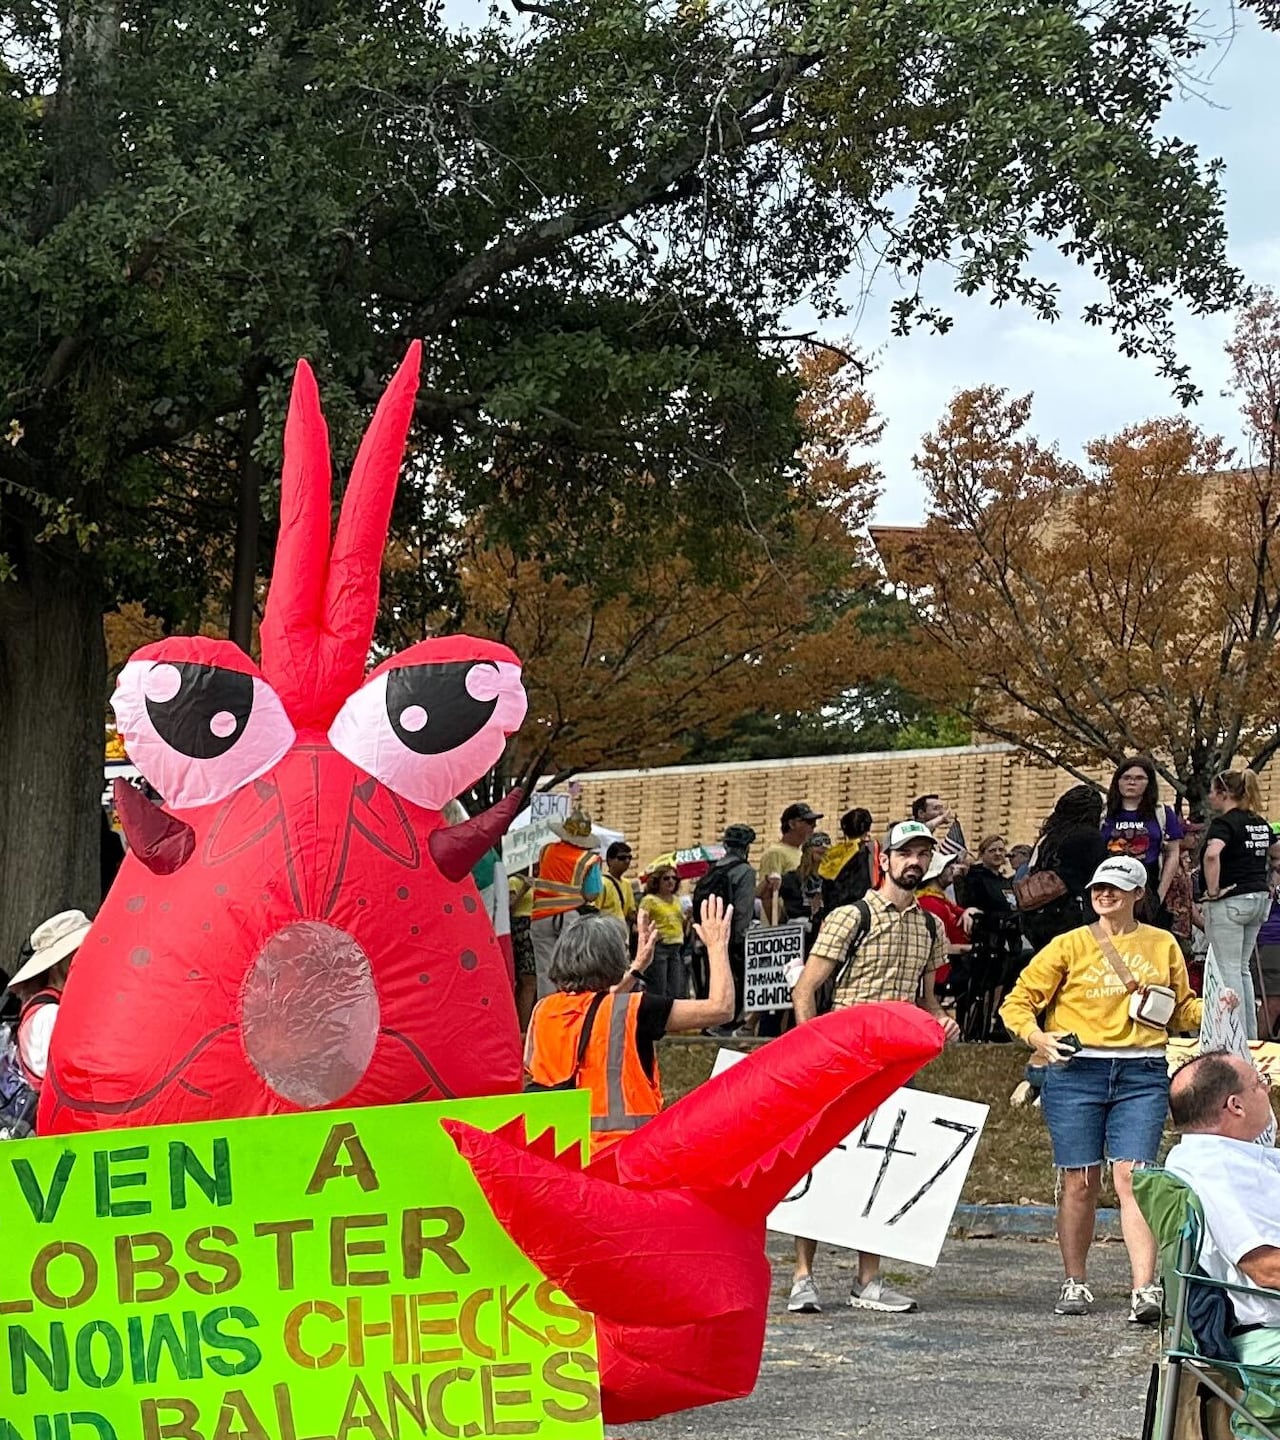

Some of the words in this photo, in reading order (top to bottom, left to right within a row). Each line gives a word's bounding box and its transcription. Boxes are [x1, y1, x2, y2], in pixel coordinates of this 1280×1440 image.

[747, 936, 801, 957] GENOCIDE
[757, 985, 793, 1006] RUMP
[305, 1121, 381, 1196] A
[283, 1281, 595, 1370] CHECKS
